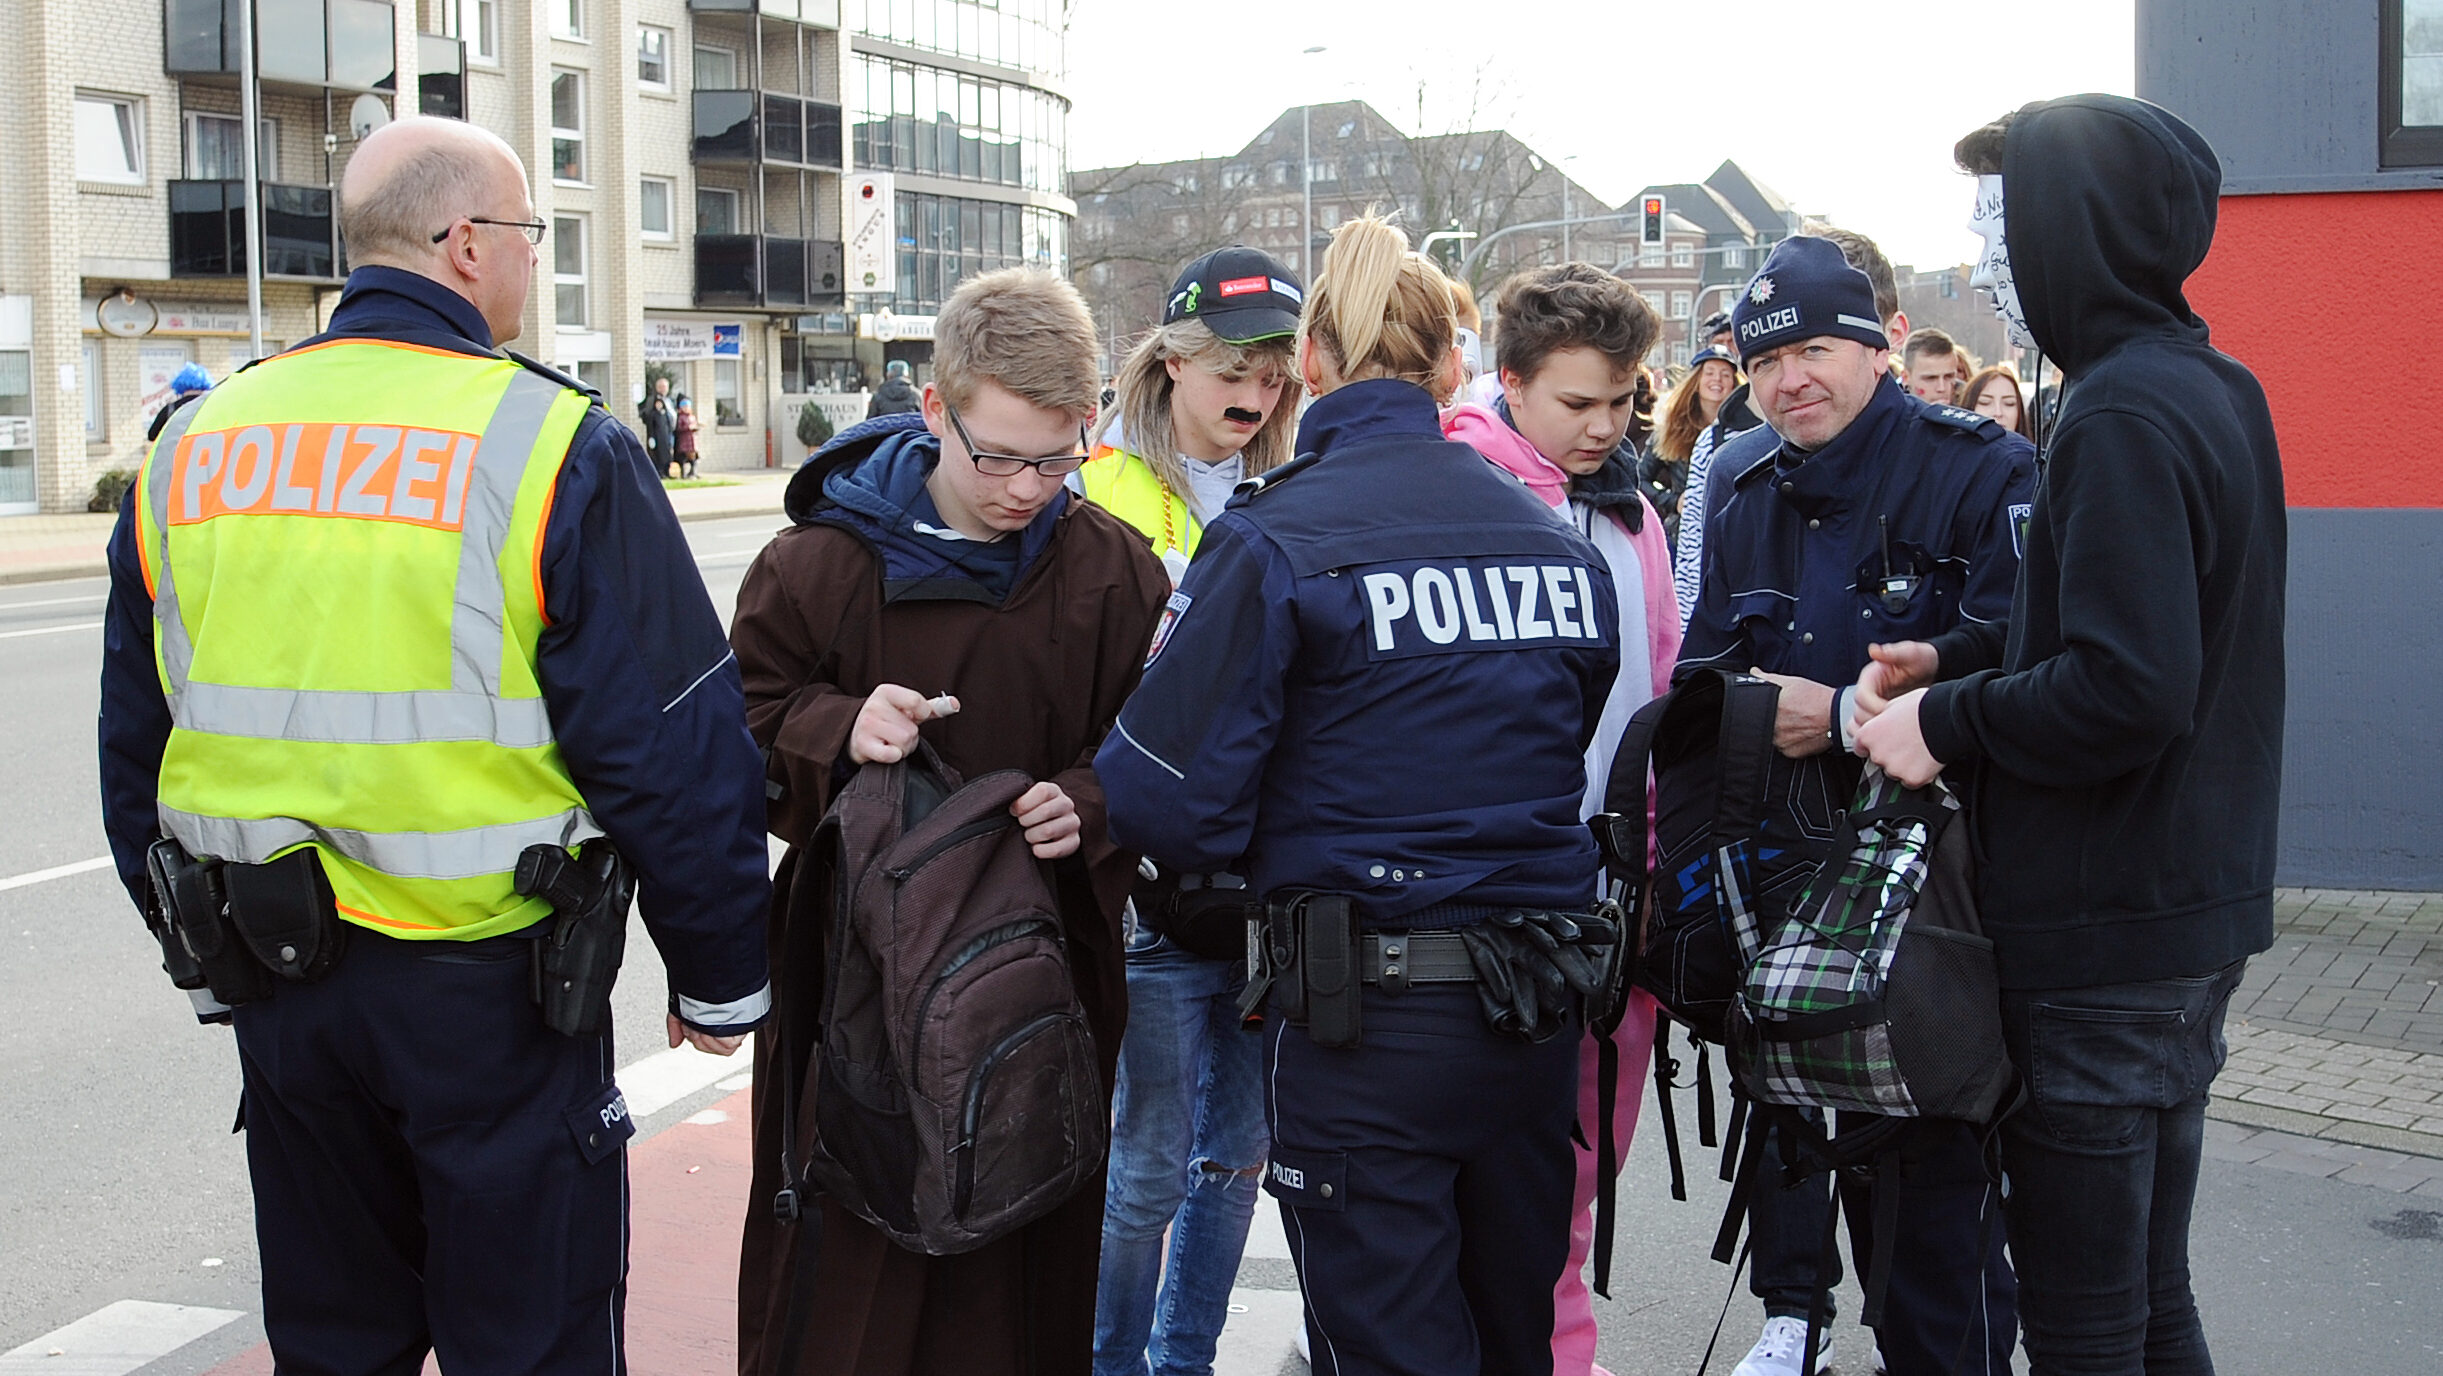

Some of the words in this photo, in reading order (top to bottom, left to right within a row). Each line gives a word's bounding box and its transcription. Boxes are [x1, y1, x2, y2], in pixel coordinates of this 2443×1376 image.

[1740, 306, 1799, 342] POLIZEI
[184, 424, 477, 525] POLIZEI
[1363, 566, 1599, 651] POLIZEI
[1272, 1160, 1305, 1190] POLIZEI
